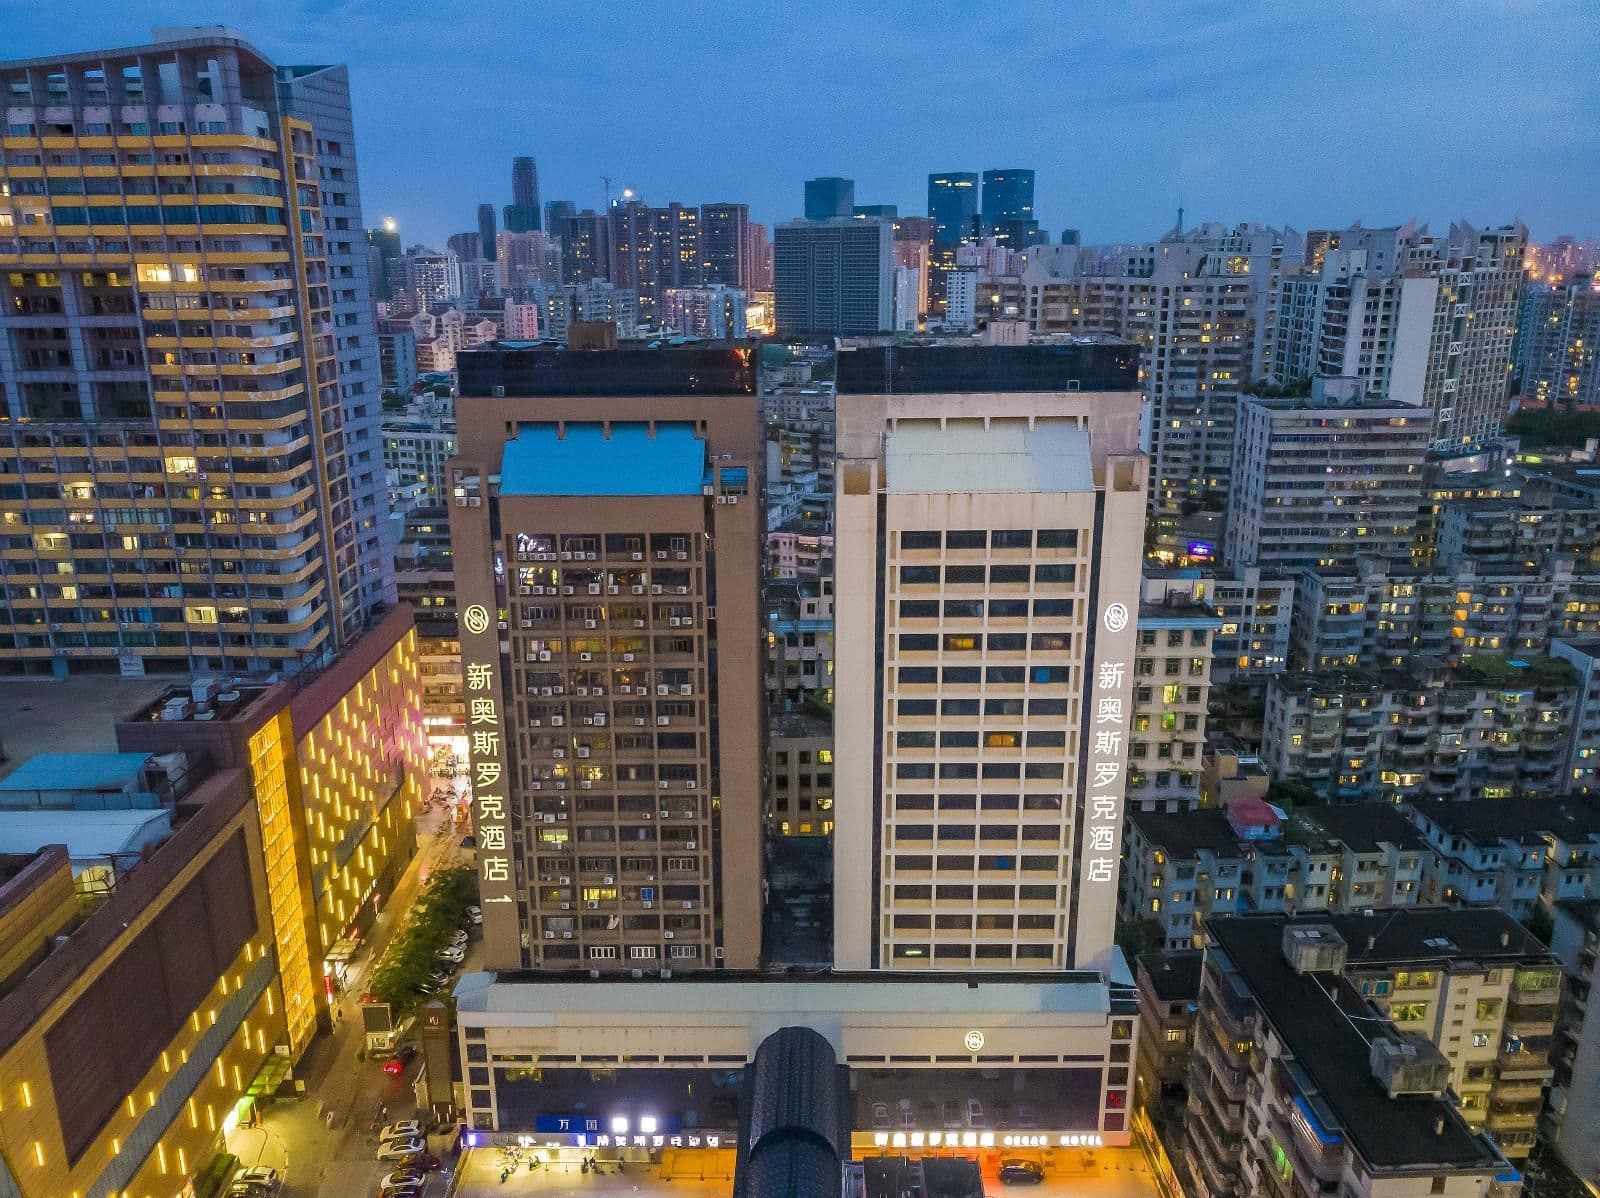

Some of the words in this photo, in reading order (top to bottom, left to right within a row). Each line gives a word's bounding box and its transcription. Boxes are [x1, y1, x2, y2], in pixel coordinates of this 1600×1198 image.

[1086, 661, 1125, 882] 新奥斯罗克酒店
[1060, 1135, 1103, 1147] HOTEL
